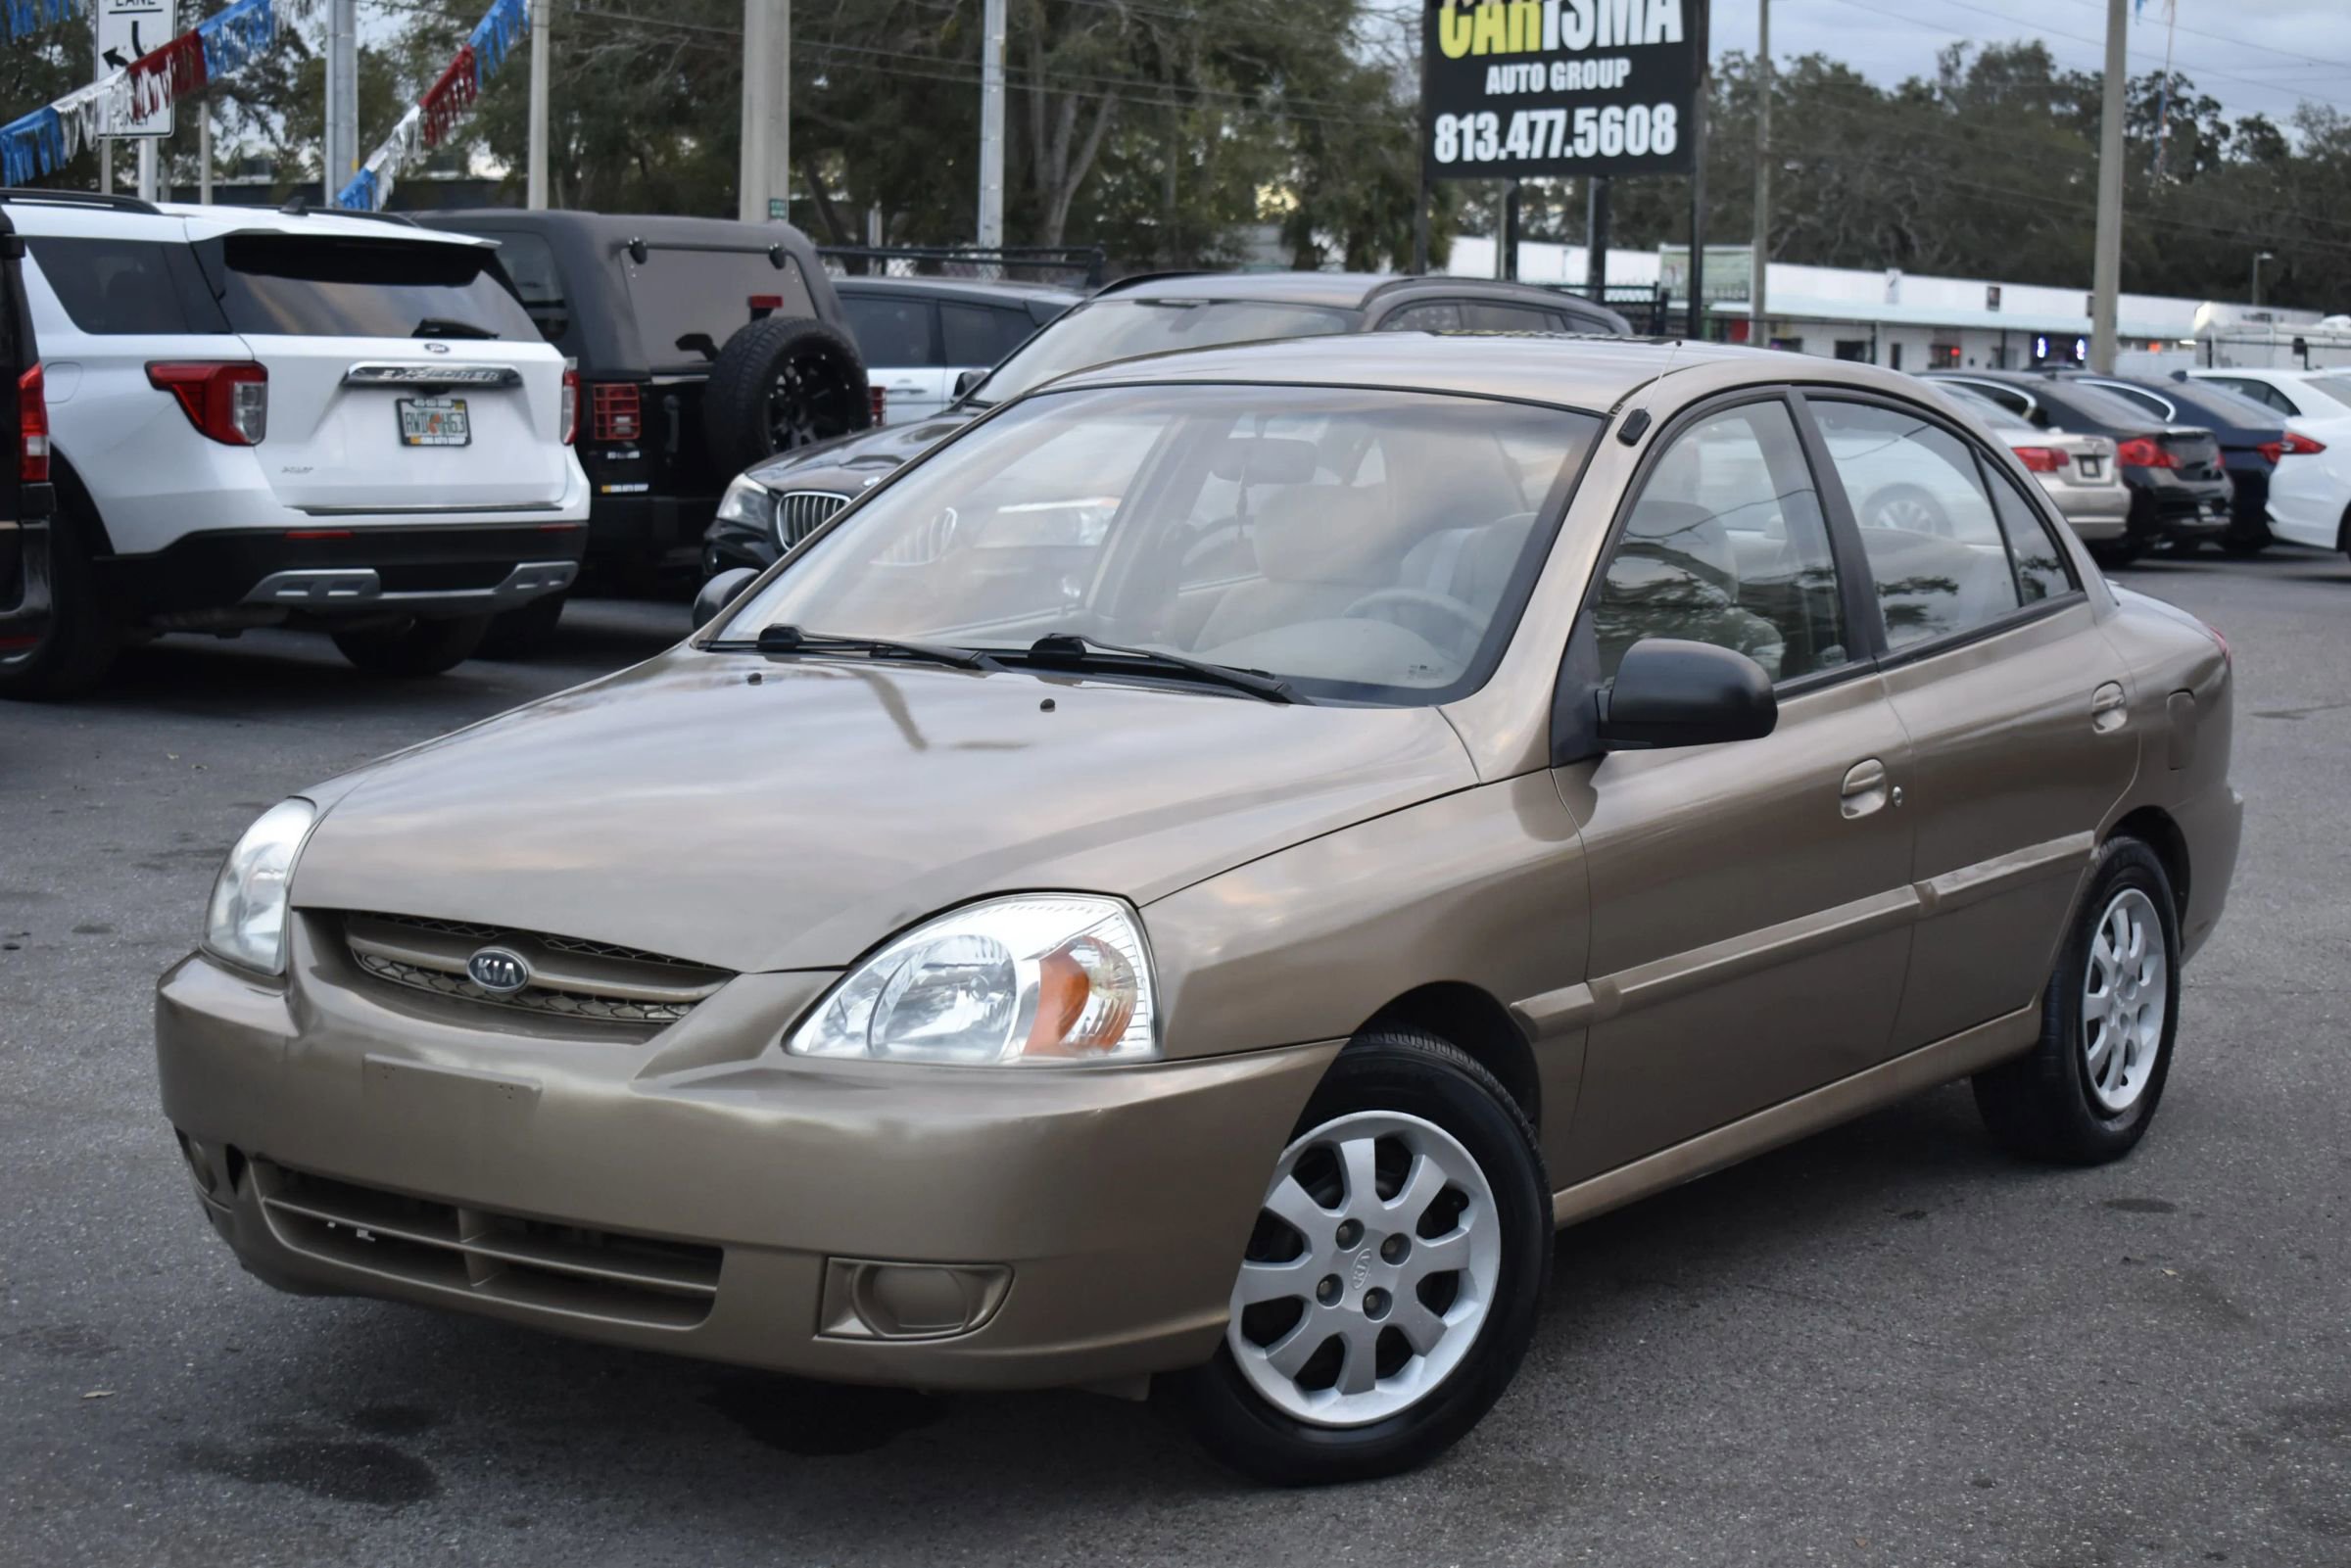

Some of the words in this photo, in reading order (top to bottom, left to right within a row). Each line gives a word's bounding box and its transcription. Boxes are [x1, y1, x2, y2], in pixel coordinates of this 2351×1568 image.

[1485, 63, 1546, 95] AUTO
[1550, 58, 1631, 92] GROUP
[1434, 103, 1678, 164] 813.477.5608
[477, 958, 517, 985] KIA
